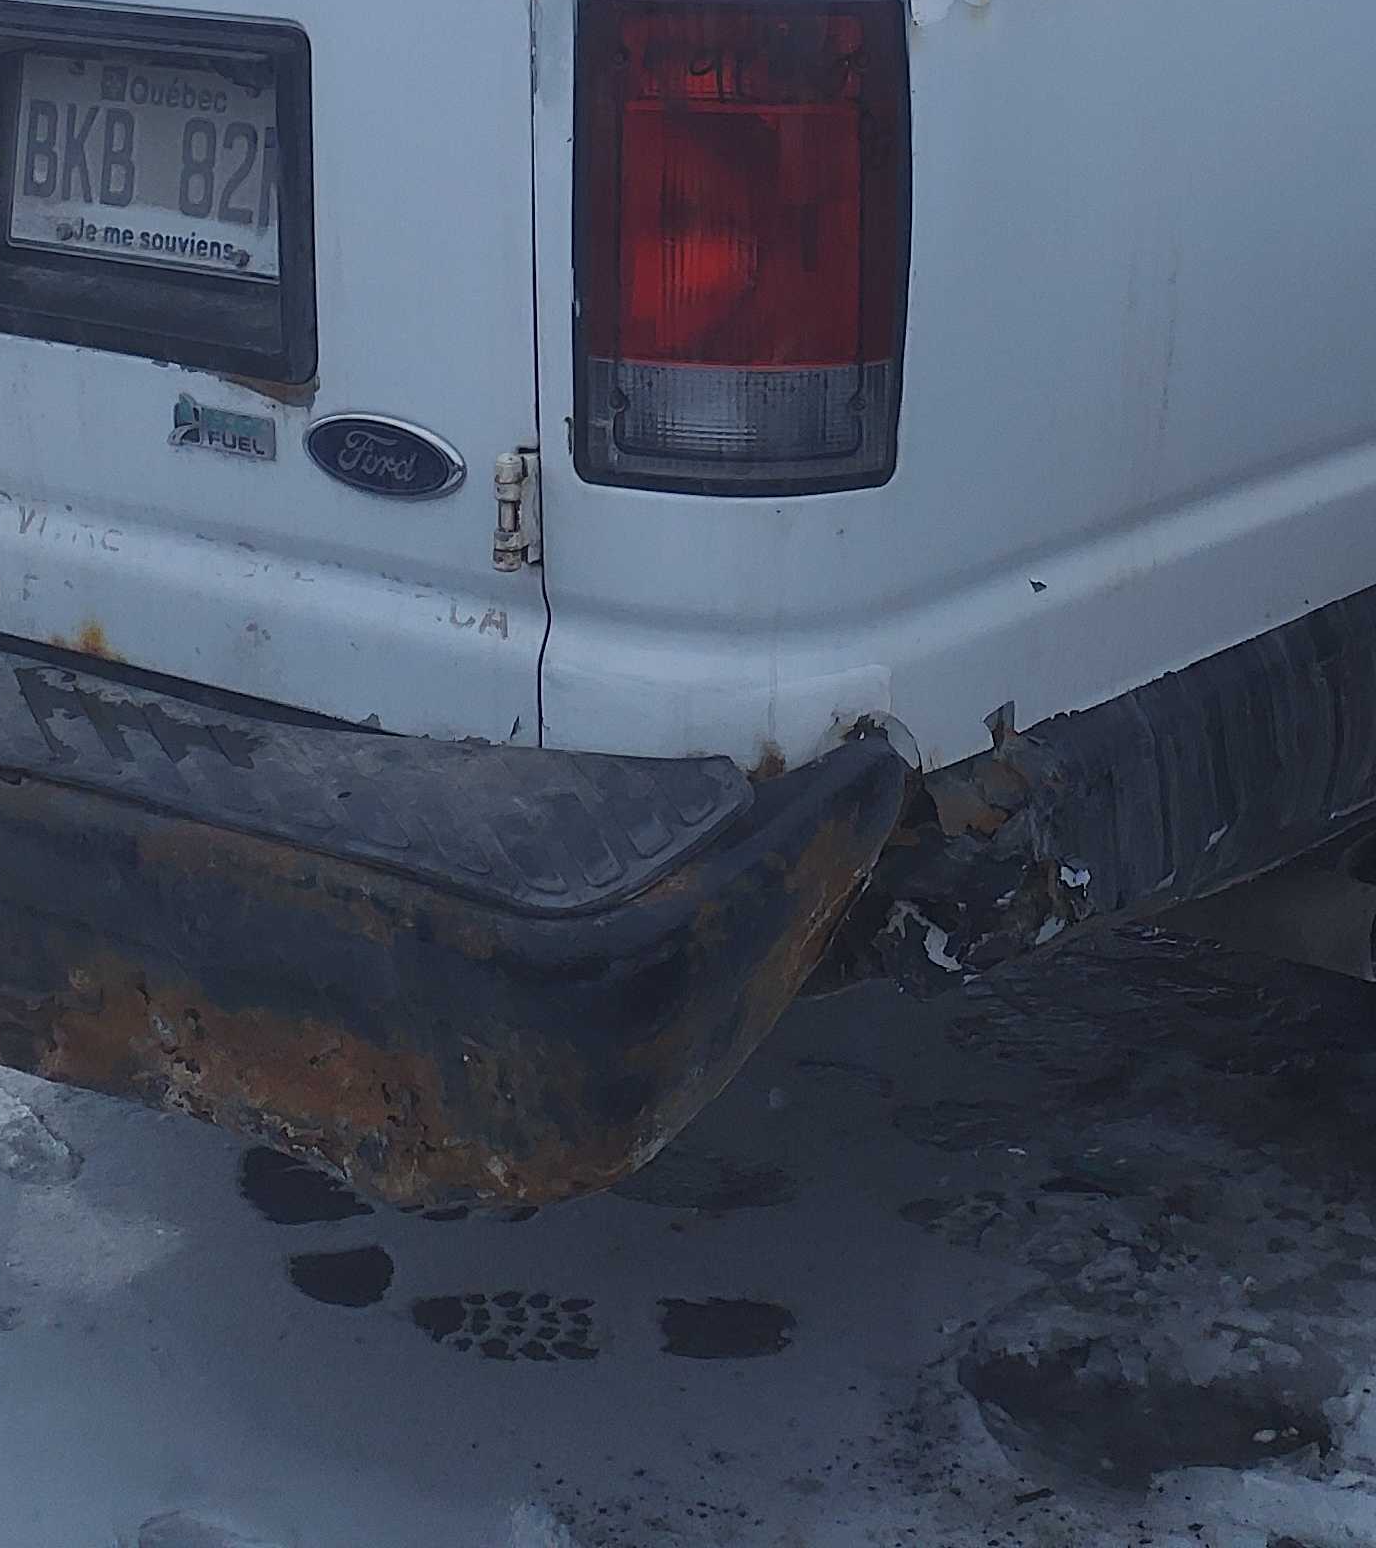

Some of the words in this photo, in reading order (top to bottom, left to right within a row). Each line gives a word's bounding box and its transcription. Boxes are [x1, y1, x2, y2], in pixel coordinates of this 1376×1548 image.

[130, 75, 227, 113] Québec
[24, 99, 136, 208] BKB
[73, 217, 97, 242] Je
[104, 226, 134, 247] me
[140, 231, 234, 261] souviens
[207, 431, 265, 455] FUEL
[337, 430, 418, 483] Ford
